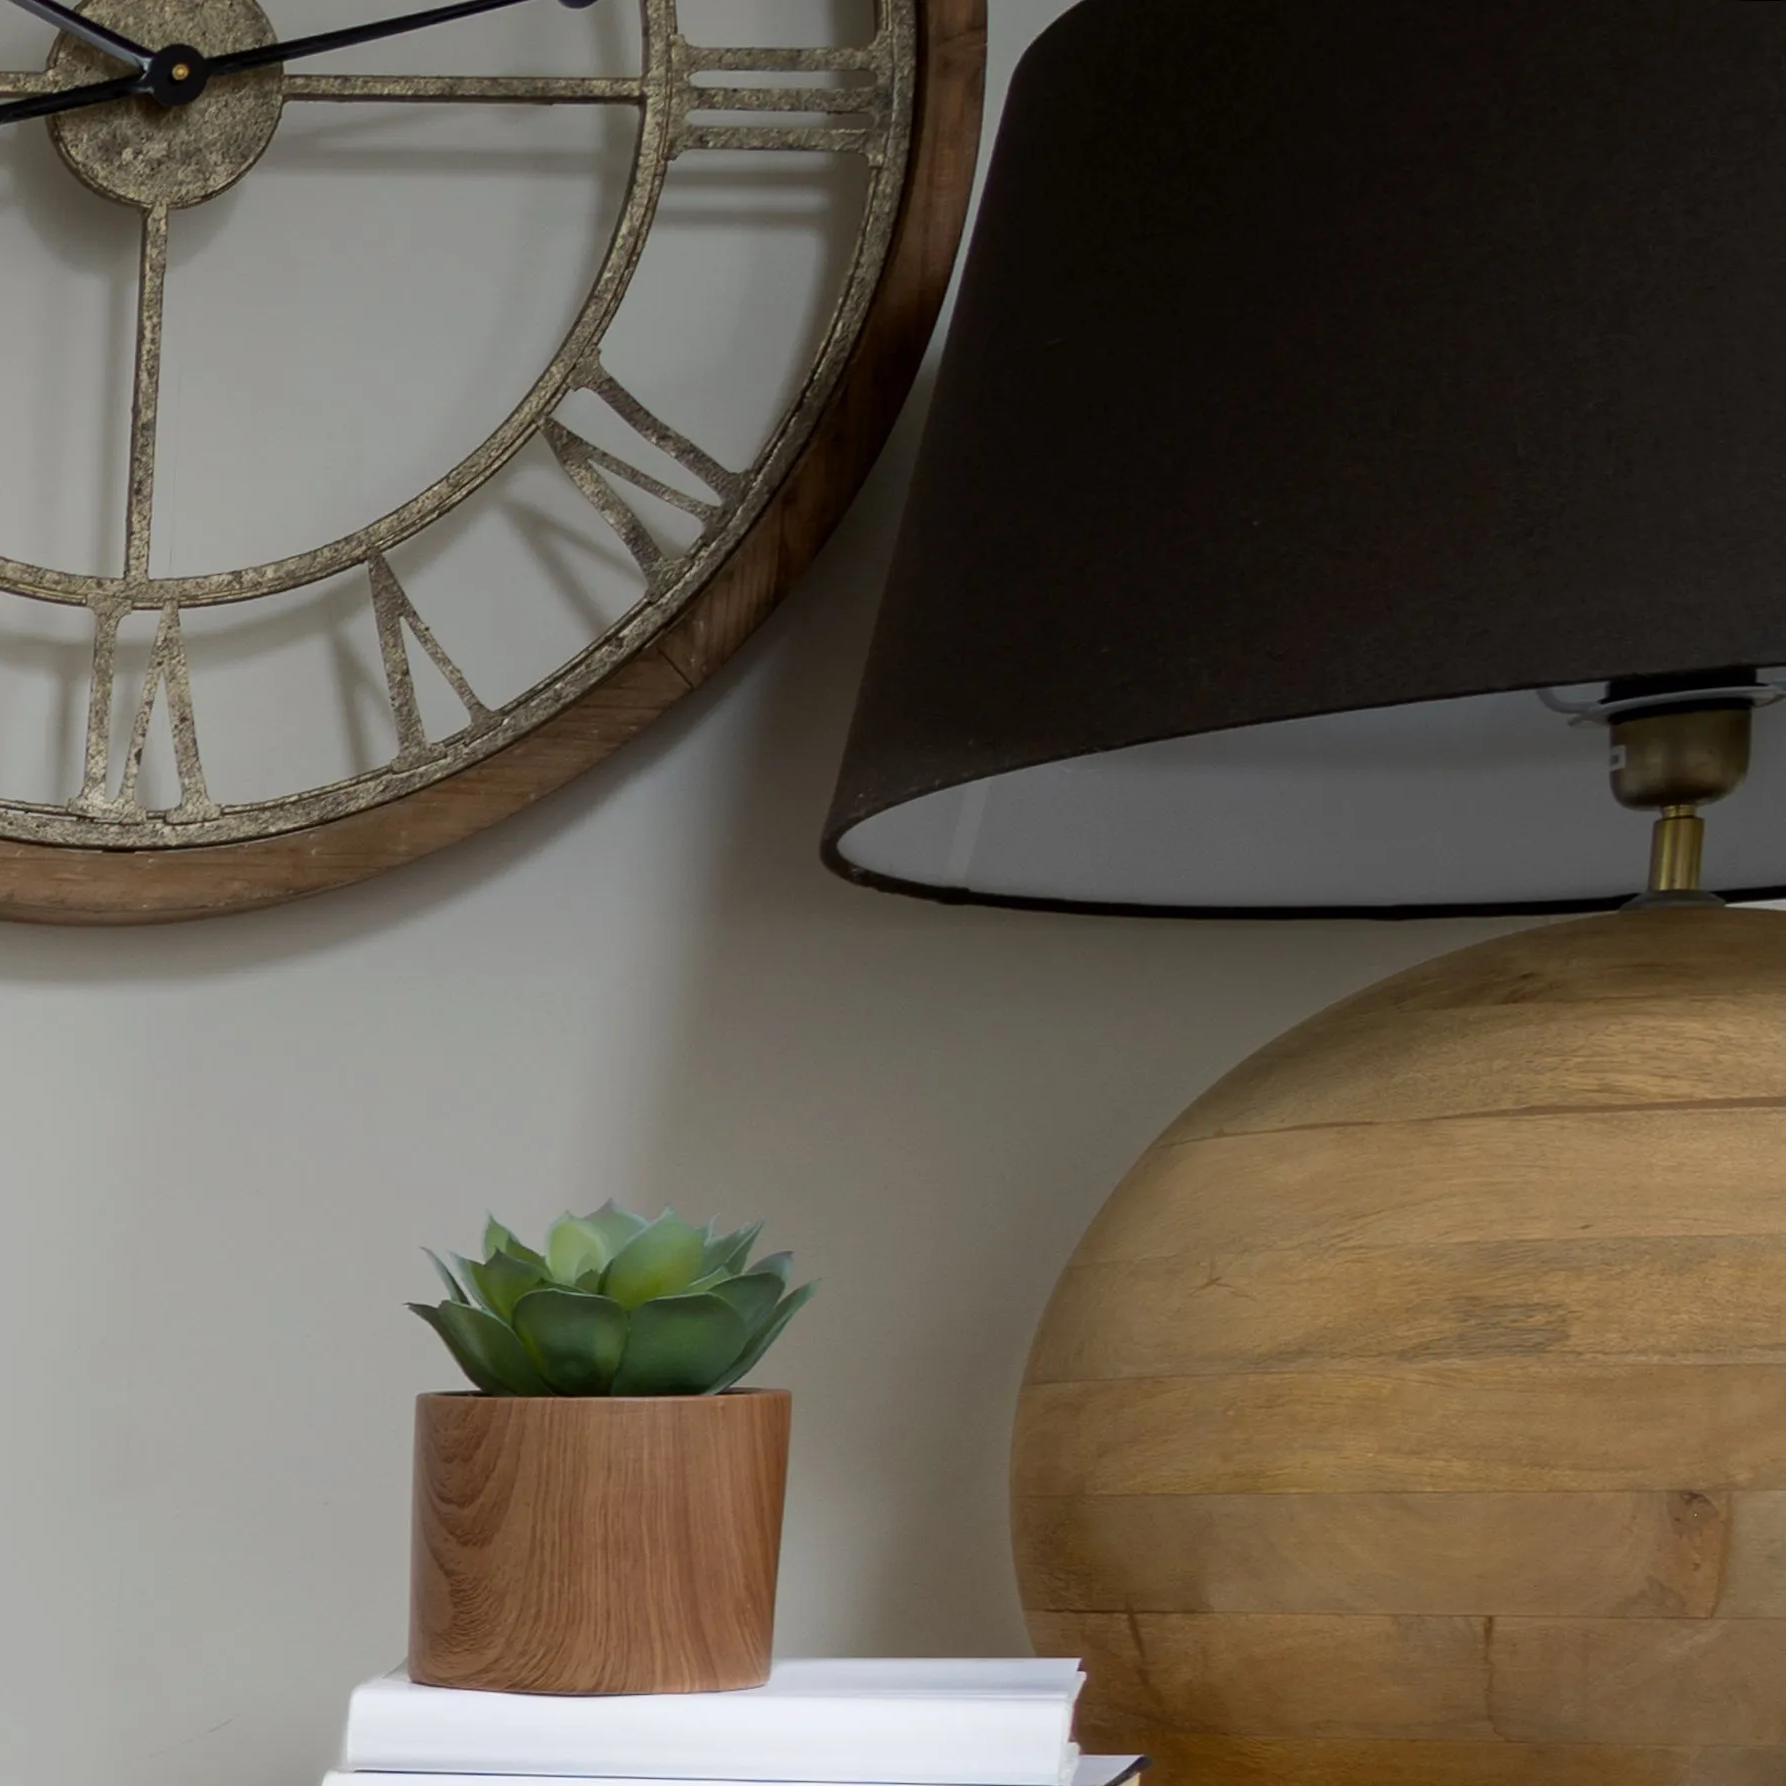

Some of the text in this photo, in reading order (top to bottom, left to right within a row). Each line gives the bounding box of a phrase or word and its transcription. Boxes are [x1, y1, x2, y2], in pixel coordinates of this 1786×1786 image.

[665, 33, 891, 167] III
[539, 349, 755, 604] IV
[68, 592, 223, 825] VI
[365, 548, 503, 774] V
